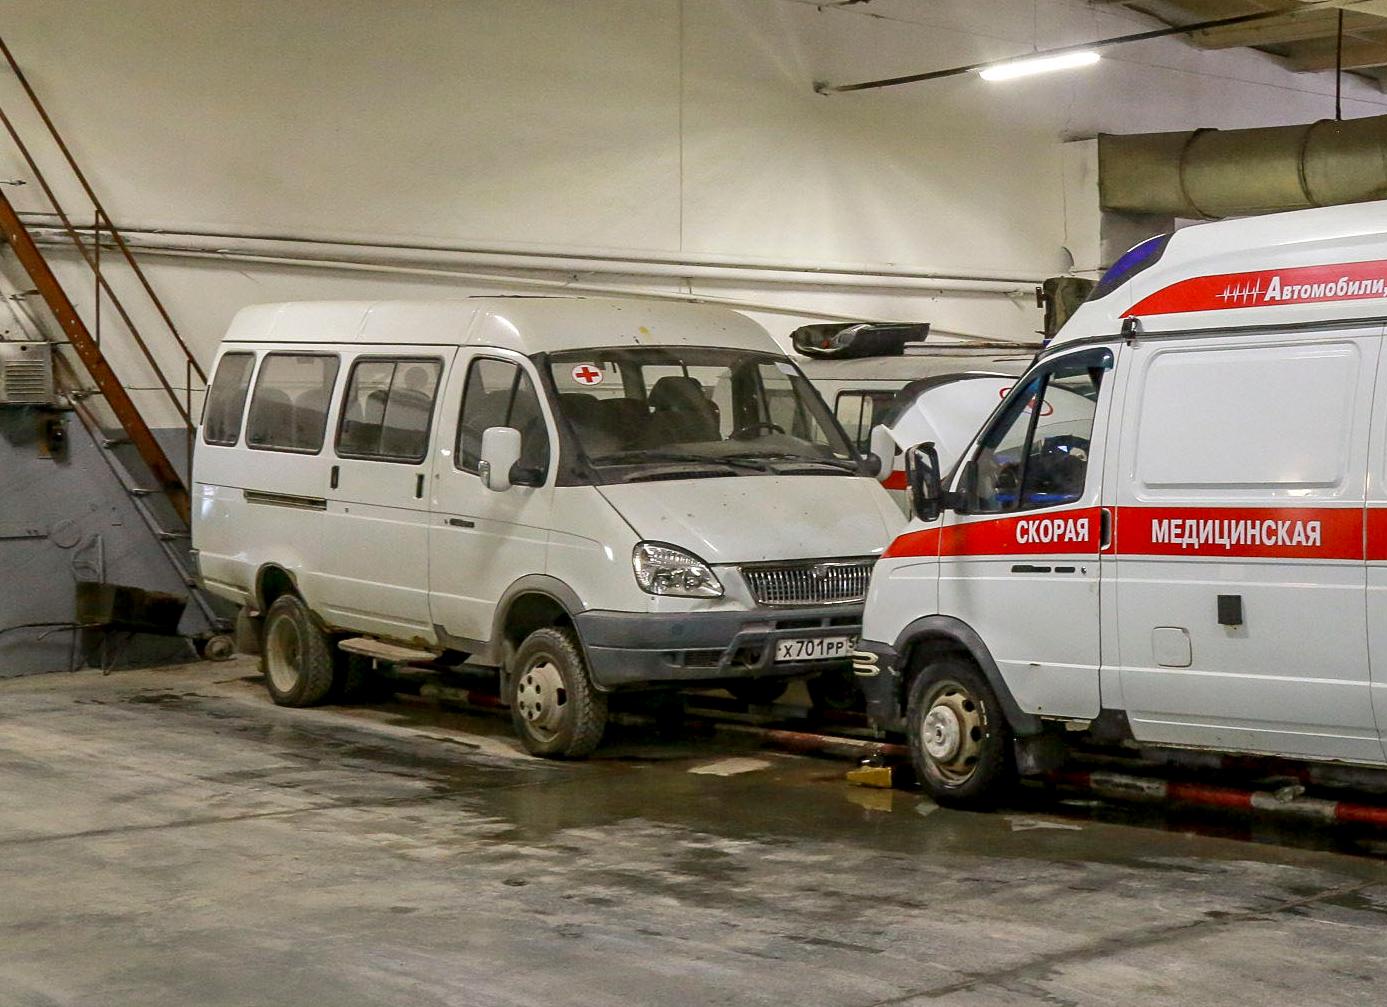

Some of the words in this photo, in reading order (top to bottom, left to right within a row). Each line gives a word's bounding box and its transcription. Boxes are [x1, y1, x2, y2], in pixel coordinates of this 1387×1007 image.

[1016, 518, 1089, 544] СКОРАЯ
[1151, 519, 1321, 549] МЕДИЦИНСКАЯ
[783, 640, 844, 657] Х701РР
